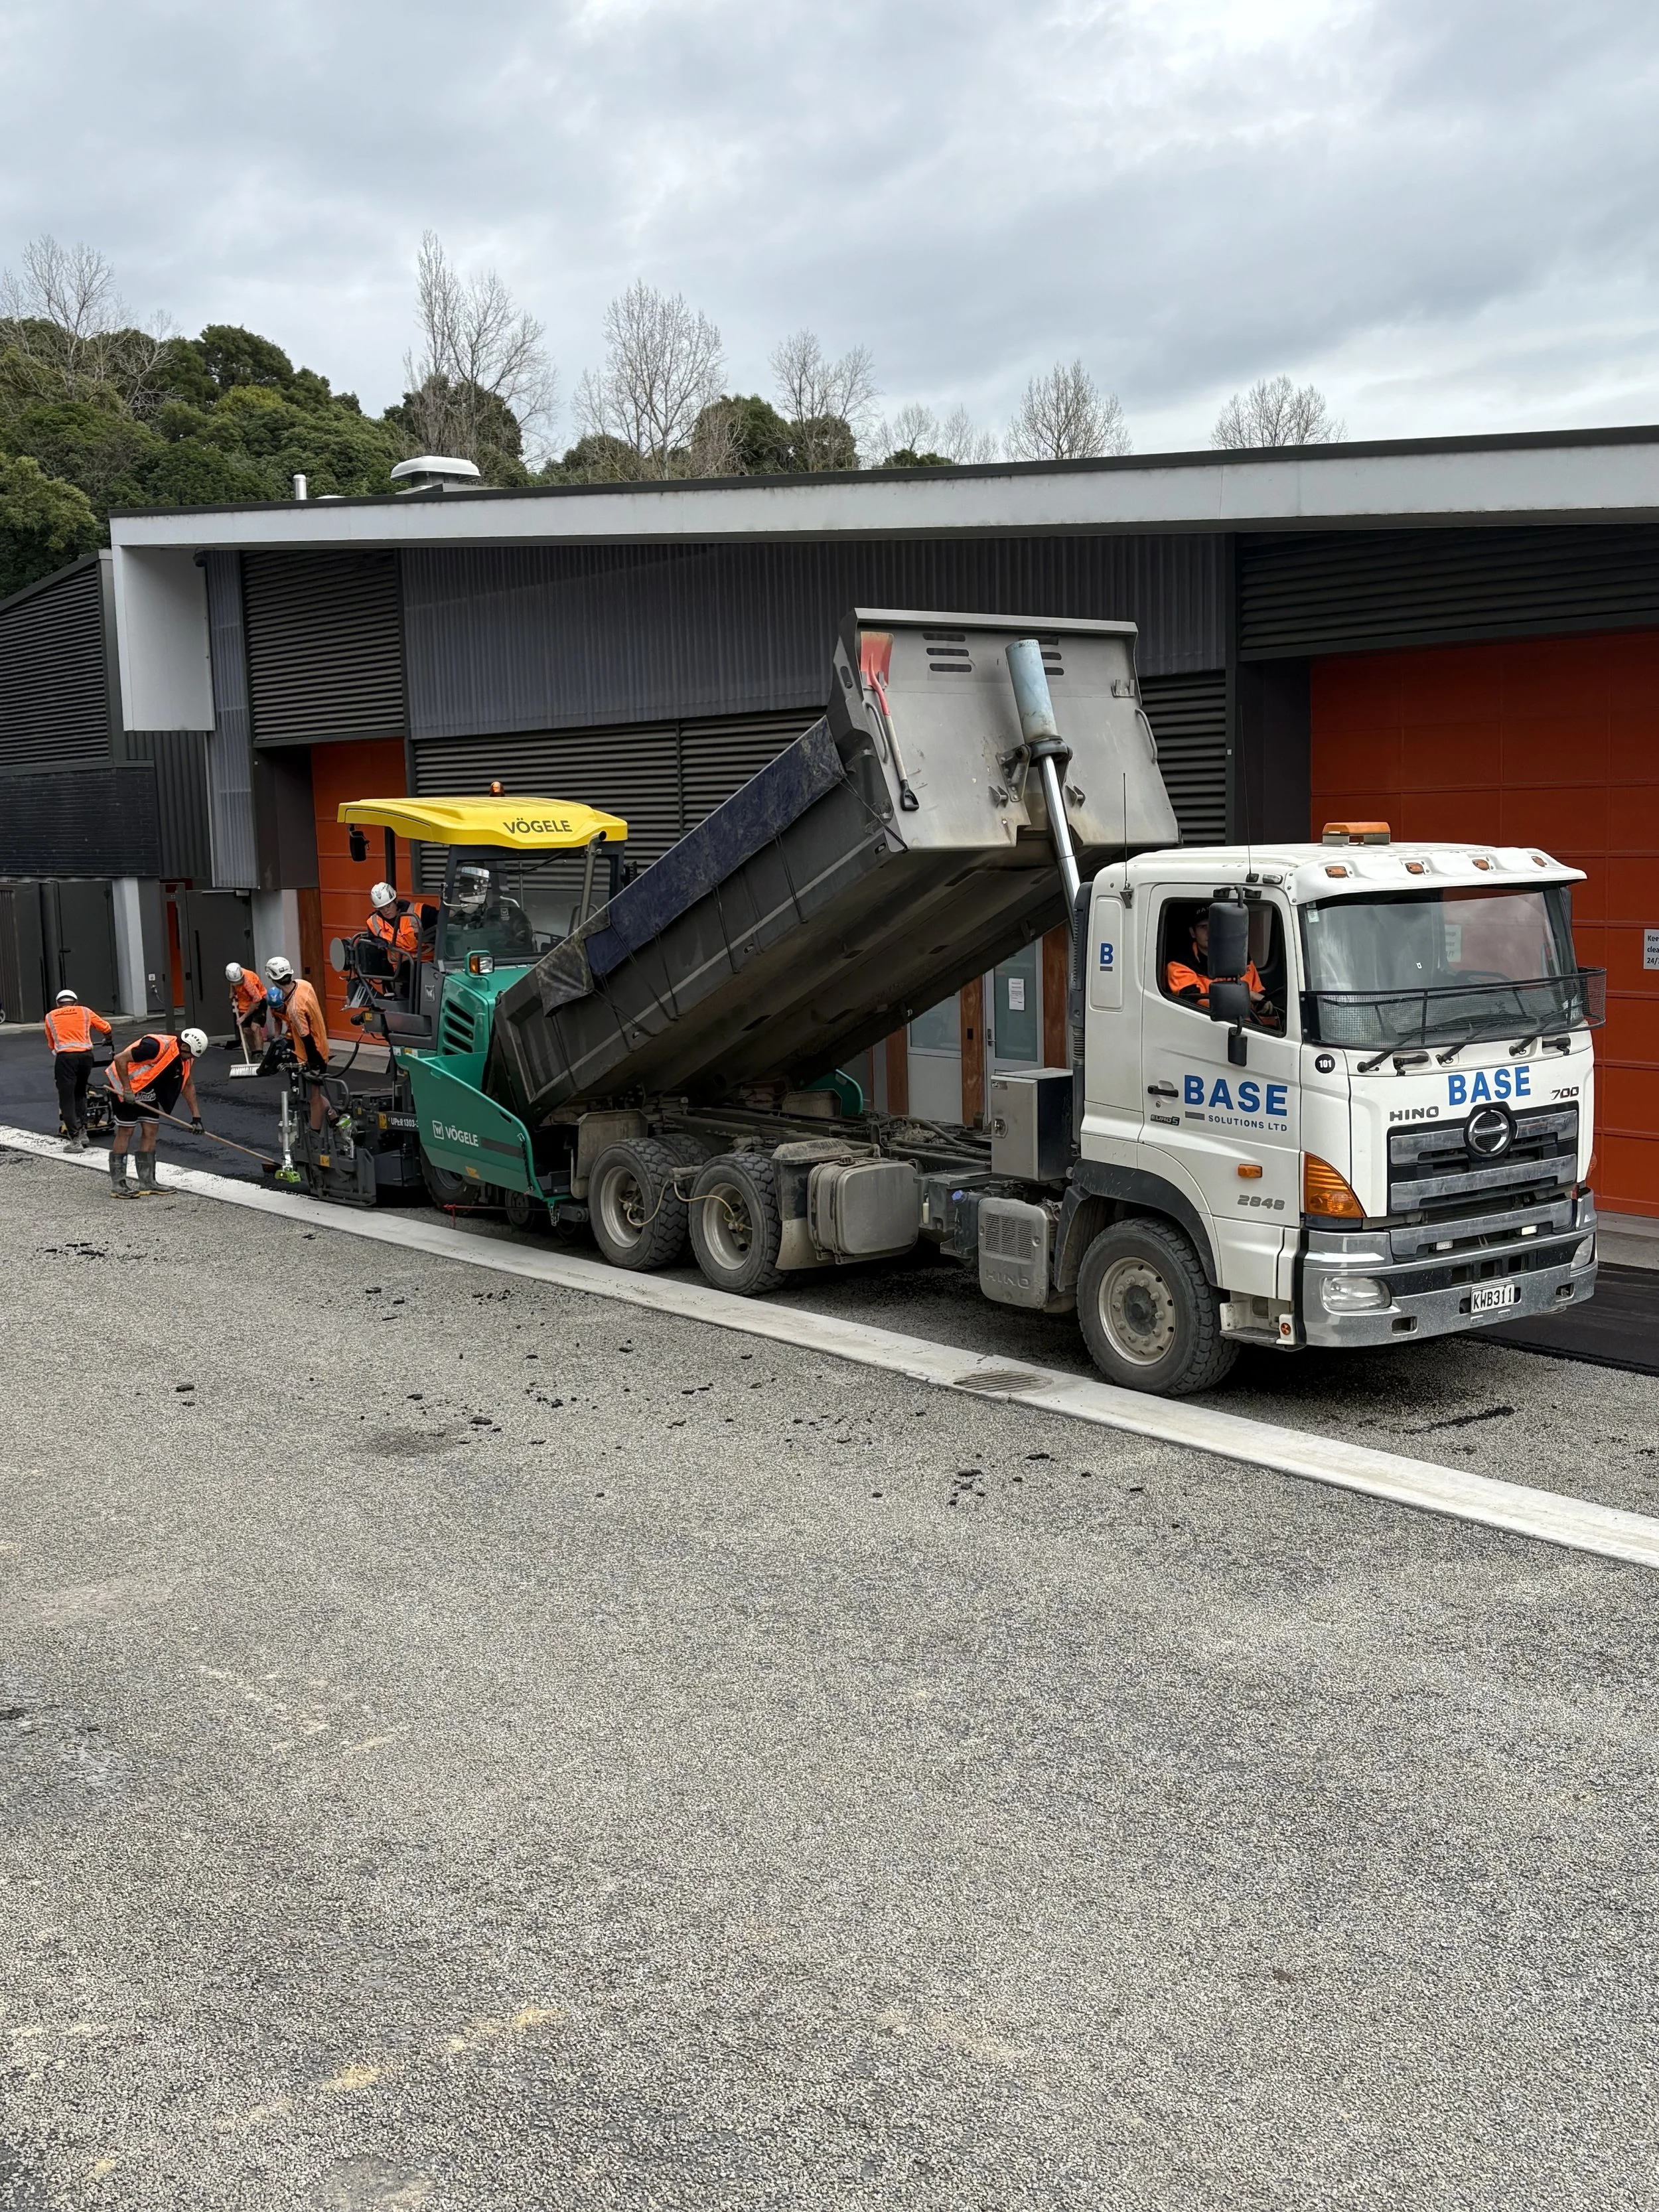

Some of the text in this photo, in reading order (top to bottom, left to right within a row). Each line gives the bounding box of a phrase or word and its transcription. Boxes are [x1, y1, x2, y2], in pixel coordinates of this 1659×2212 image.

[502, 818, 573, 834] VÖGELE
[1100, 942, 1114, 964] B
[1646, 957, 1659, 966] 24/
[1319, 1059, 1332, 1069] 101
[1448, 1065, 1531, 1106] BASE
[1550, 1086, 1579, 1100] 700
[1184, 1074, 1288, 1116] BASE
[1208, 1114, 1288, 1132] SOLUTIONS LTD
[1389, 1106, 1439, 1122] HINO
[445, 1125, 479, 1147] VÖGELE
[1237, 1194, 1285, 1211] 2848
[985, 1268, 1030, 1290] HINO
[1473, 1287, 1512, 1310] KWB311
